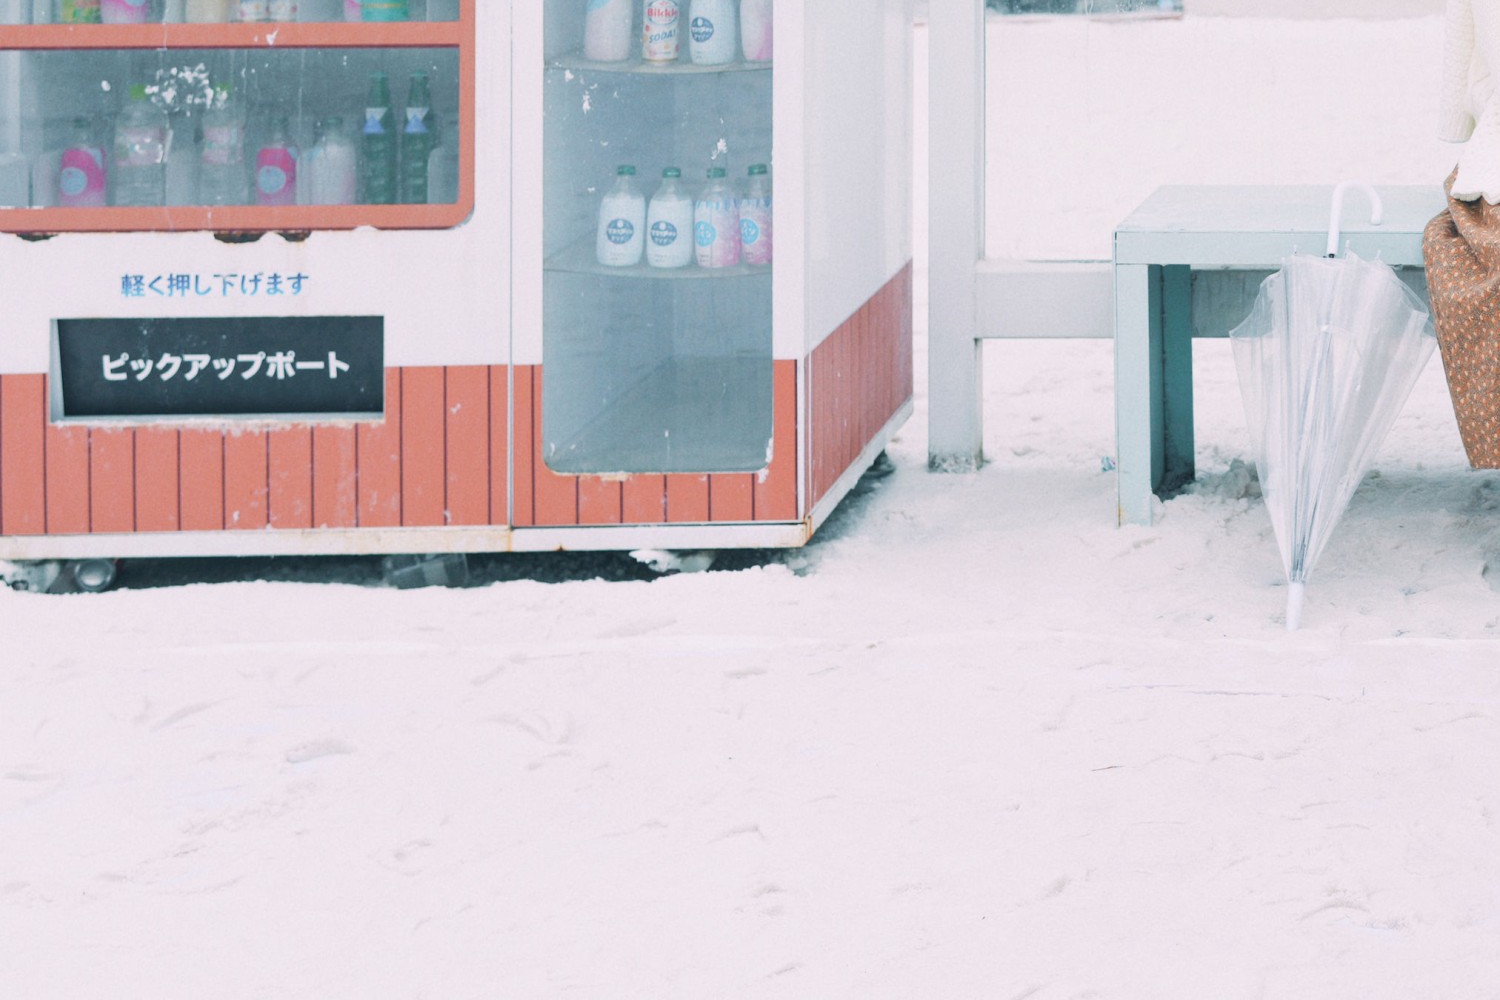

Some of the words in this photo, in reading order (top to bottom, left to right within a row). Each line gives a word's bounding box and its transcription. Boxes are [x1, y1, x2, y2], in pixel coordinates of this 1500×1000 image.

[120, 272, 309, 298] 軽く押し下げます
[102, 350, 350, 382] ピックアップポート
